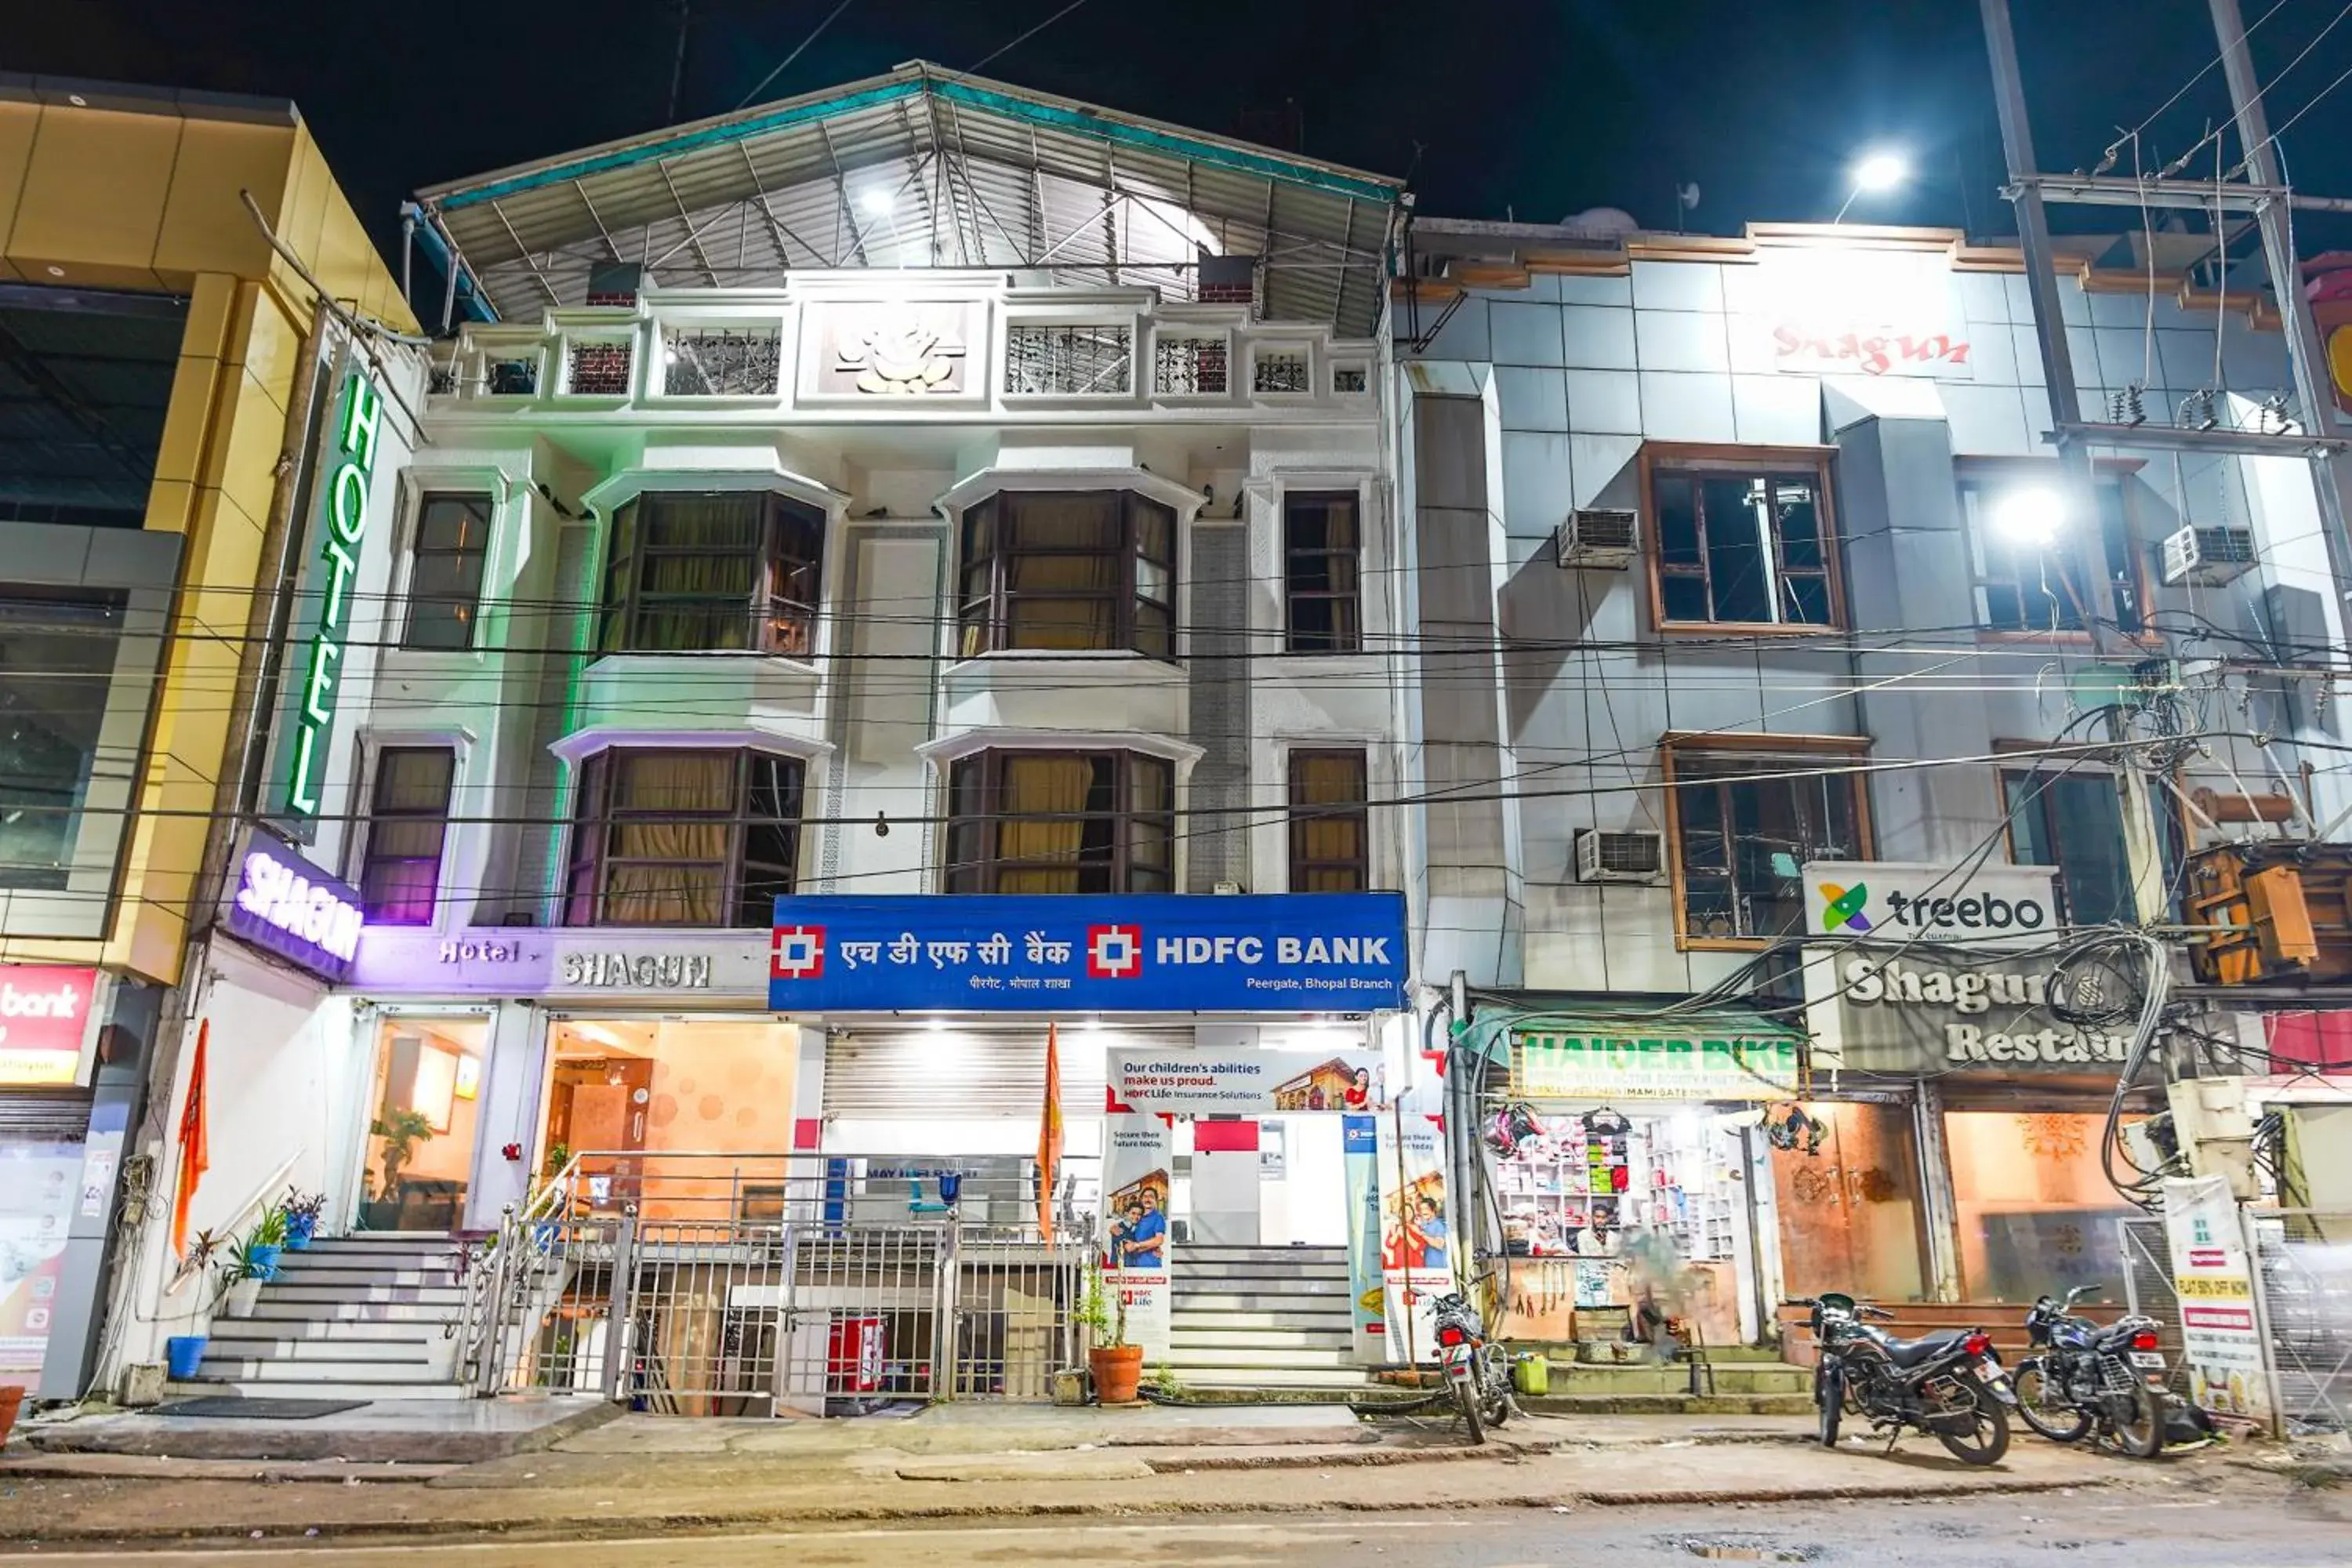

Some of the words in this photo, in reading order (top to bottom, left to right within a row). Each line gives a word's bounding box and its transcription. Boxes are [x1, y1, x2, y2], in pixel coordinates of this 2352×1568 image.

[287, 373, 383, 815] HOTEL
[238, 852, 363, 962] SHAGUN
[1886, 890, 2044, 929] treebo
[438, 940, 519, 964] Hotel
[564, 953, 711, 988] SHAGUN
[840, 941, 881, 970] एच
[887, 932, 920, 964] डी
[927, 941, 971, 969] एफ
[977, 932, 1011, 965] सी
[1024, 931, 1072, 964] बैंक
[1156, 937, 1264, 964] HDFC
[1276, 937, 1392, 964] BANK
[1, 983, 78, 1018] bank
[1247, 978, 1302, 990] Peergate,
[1305, 978, 1347, 990] Bhopal
[1350, 978, 1393, 989] Branch
[1844, 959, 2065, 1013] Shagun
[1123, 1062, 1146, 1074] Our
[1149, 1062, 1209, 1074] children's
[1210, 1062, 1261, 1075] abilities
[1525, 1036, 1695, 1070] HAIDER
[1701, 1040, 1798, 1072] BIKE
[1123, 1075, 1158, 1086] make
[1160, 1077, 1175, 1086] us
[1177, 1076, 1218, 1087] proud.
[1123, 1089, 1150, 1098] HDFC
[1152, 1087, 1172, 1098] Life
[1174, 1090, 1217, 1099] Insurance
[1218, 1090, 1262, 1100] Solutions
